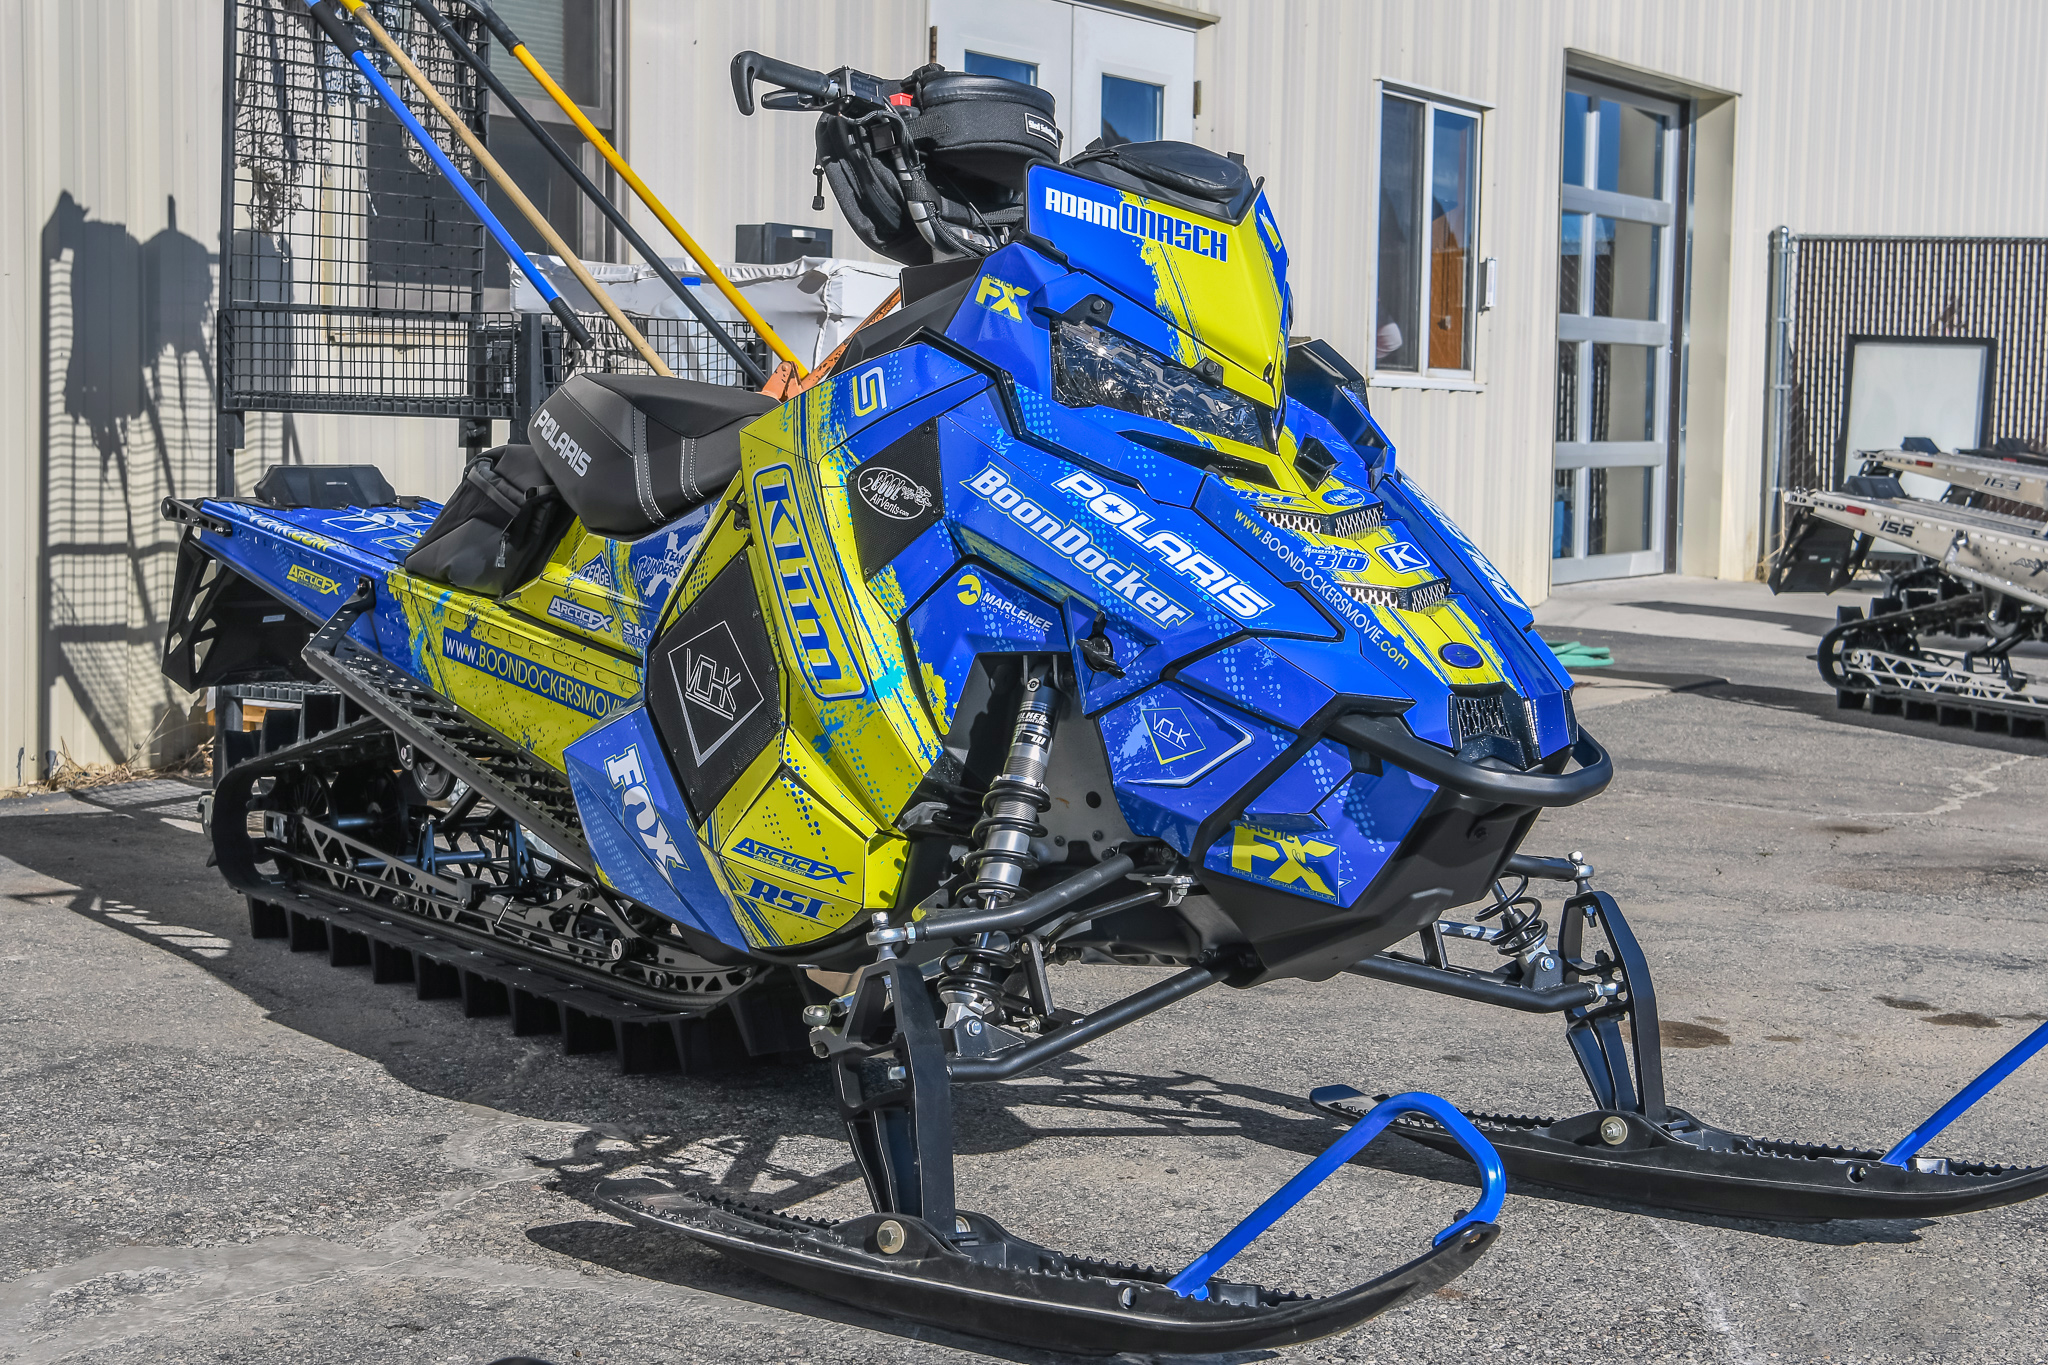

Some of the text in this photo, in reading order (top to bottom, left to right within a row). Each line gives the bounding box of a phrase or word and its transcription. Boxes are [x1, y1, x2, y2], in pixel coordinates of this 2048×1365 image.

[975, 276, 1031, 322] FX
[533, 408, 593, 478] POLARIS
[1983, 477, 2022, 492] 163
[964, 464, 1190, 627] BoonDocker
[1055, 471, 1274, 616] POLARIS
[1879, 520, 1916, 538] 155
[1384, 545, 1424, 571] K
[981, 591, 1054, 632] MARLENEE
[605, 744, 692, 889] FOX
[1231, 824, 1339, 897] FX
[741, 871, 835, 924] RSI
